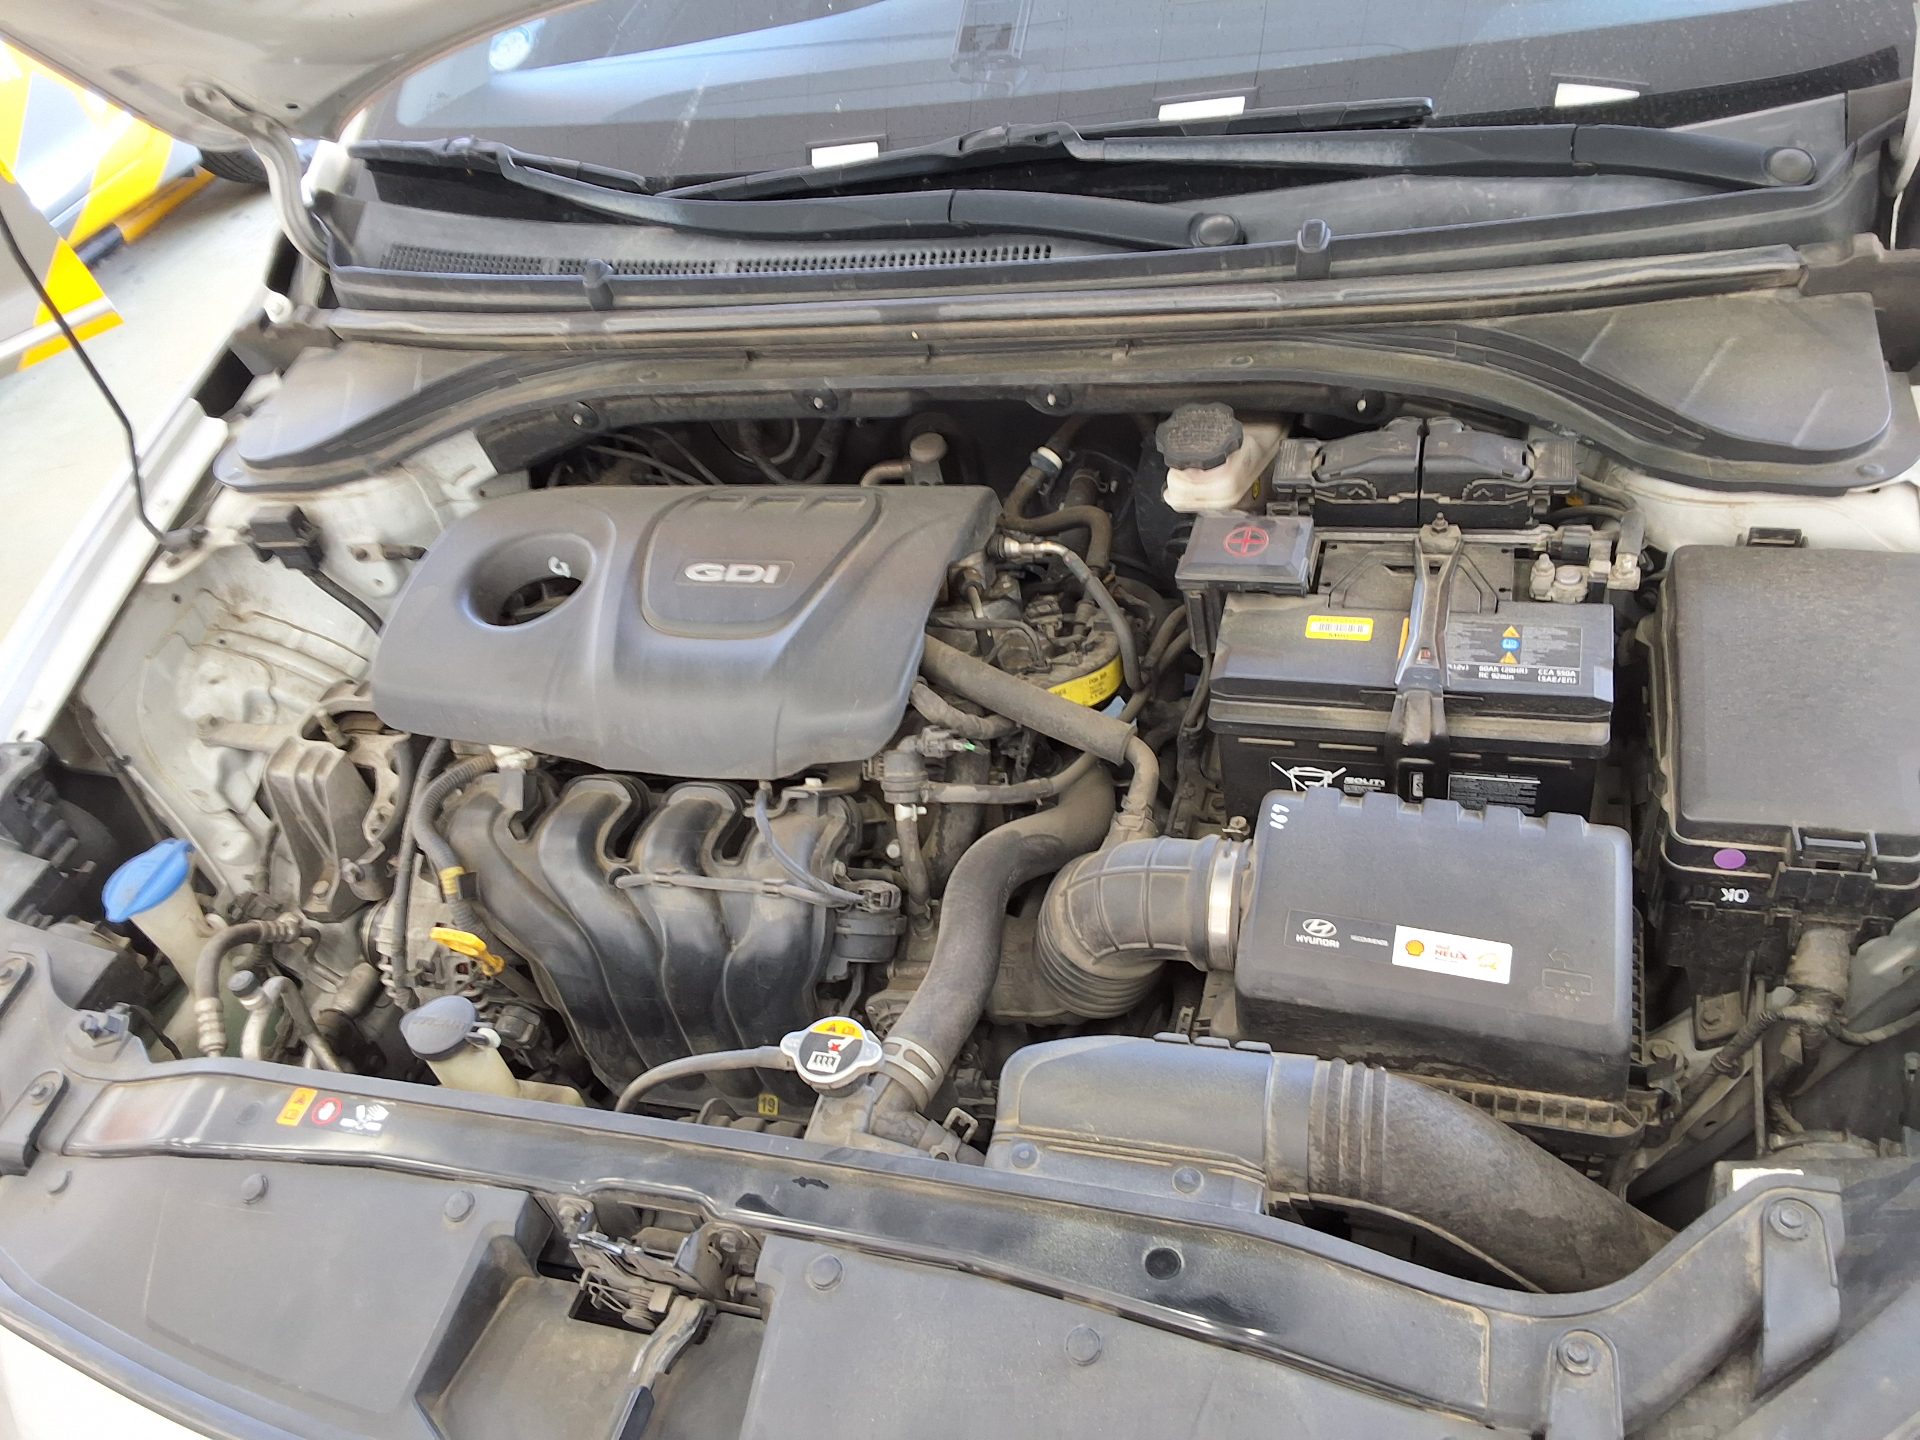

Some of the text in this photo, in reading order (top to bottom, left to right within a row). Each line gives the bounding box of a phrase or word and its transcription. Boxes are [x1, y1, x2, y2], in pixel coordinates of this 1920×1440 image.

[684, 563, 780, 584] GDI
[1720, 888, 1749, 903] OK
[1295, 934, 1340, 949] HYUNDAI
[1434, 949, 1468, 961] HELIX
[761, 1096, 775, 1113] 19
